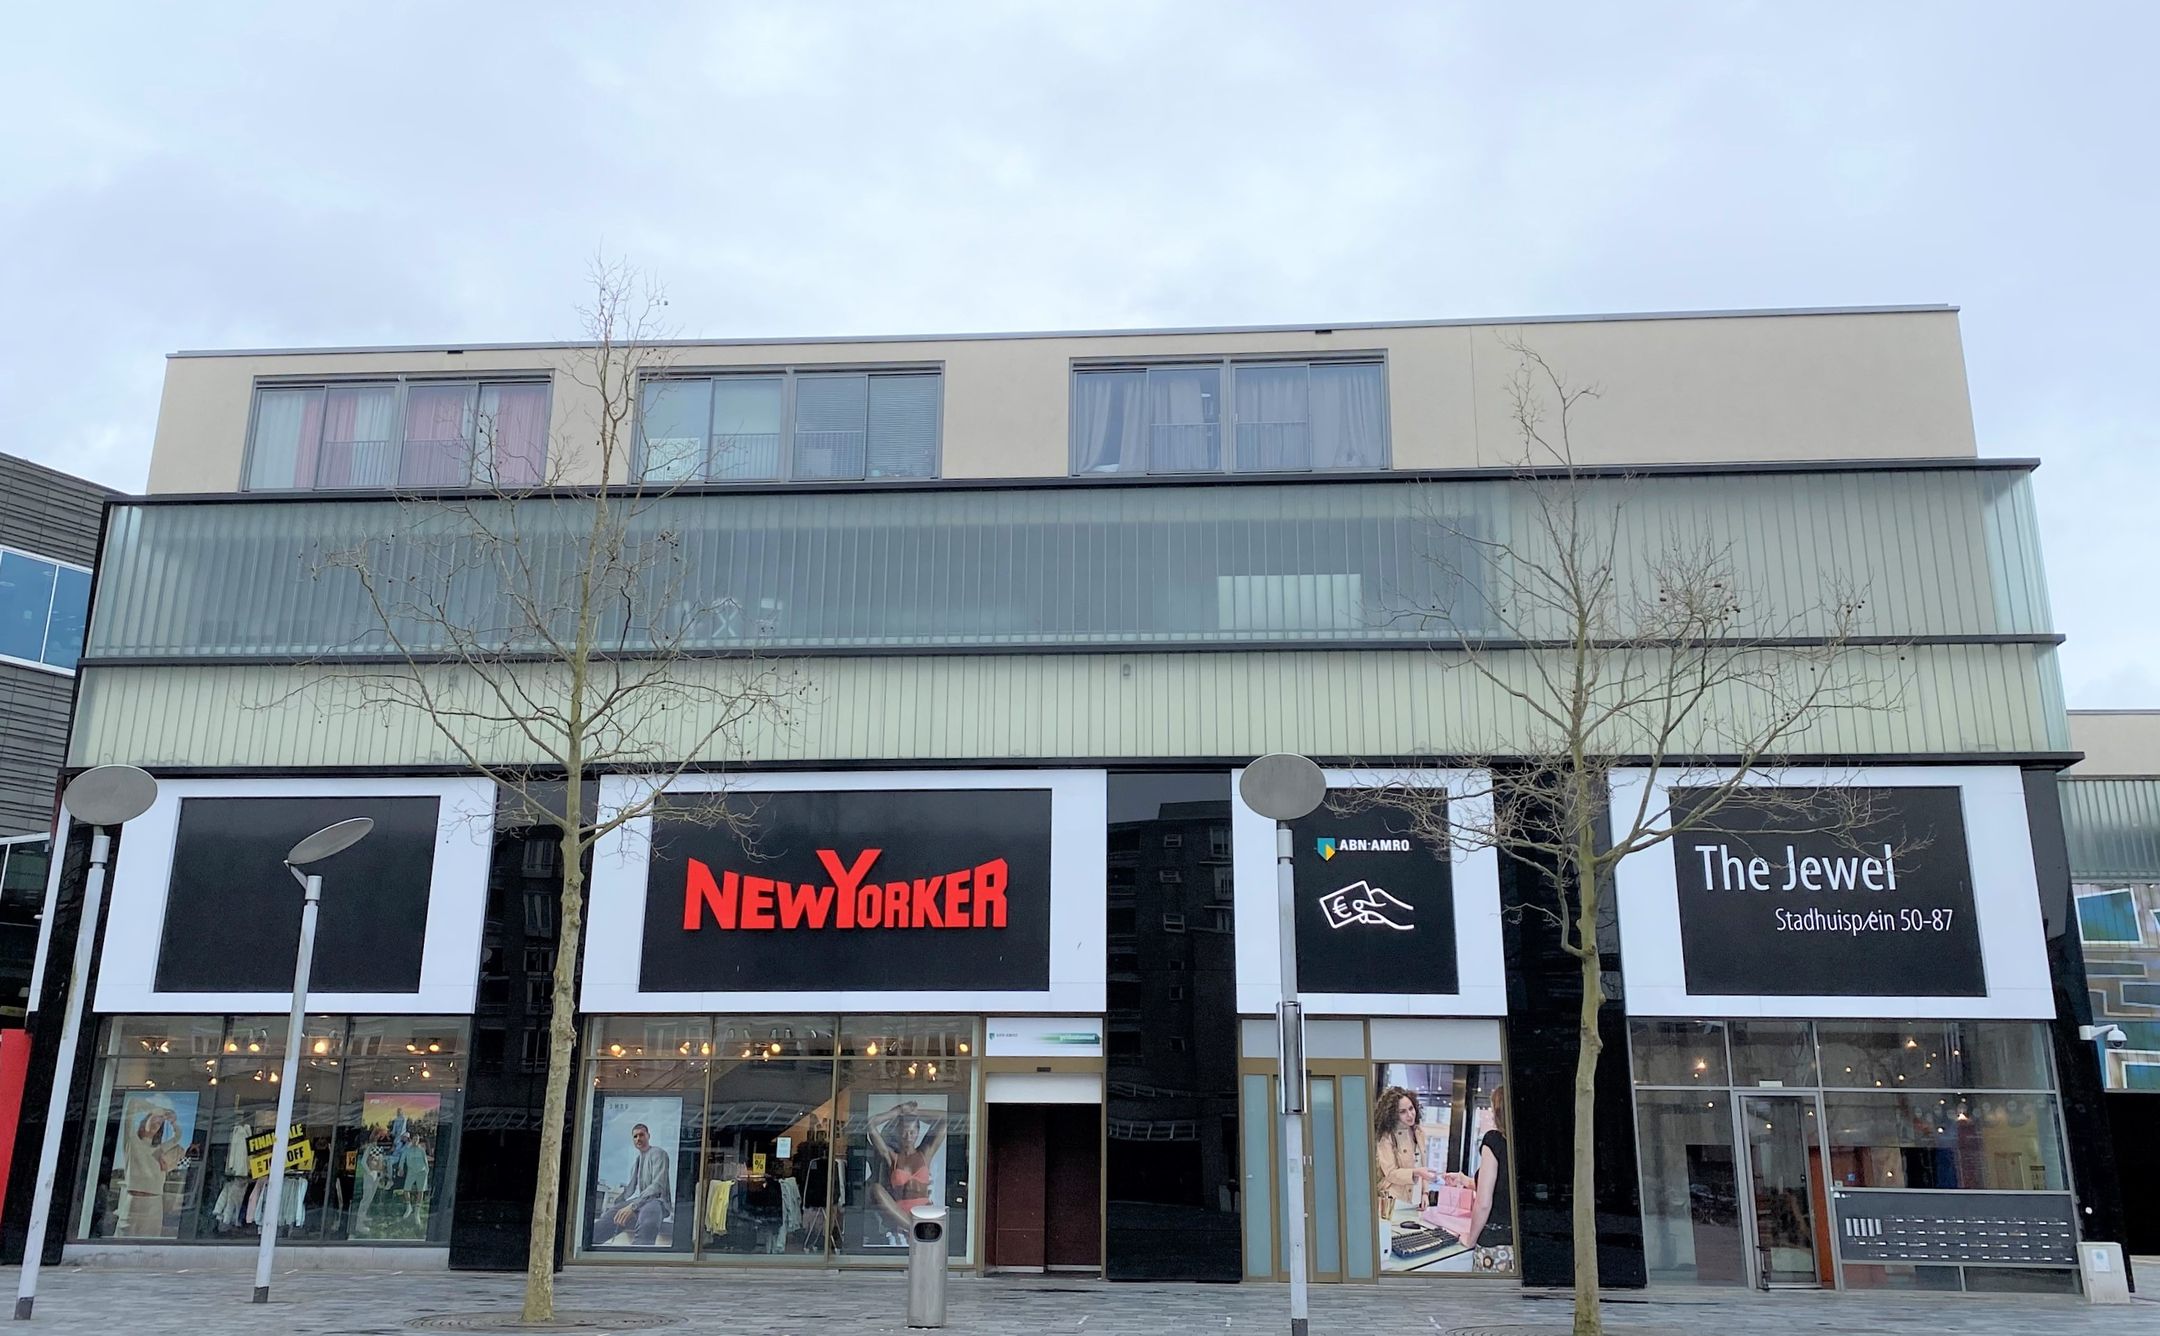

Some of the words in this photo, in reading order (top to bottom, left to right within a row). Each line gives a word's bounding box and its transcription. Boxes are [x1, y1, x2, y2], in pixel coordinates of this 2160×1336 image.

[1695, 844, 1770, 891] The
[1782, 844, 1897, 891] Jewel
[1900, 909, 1953, 932] 50-87
[287, 1146, 304, 1162] OFF
